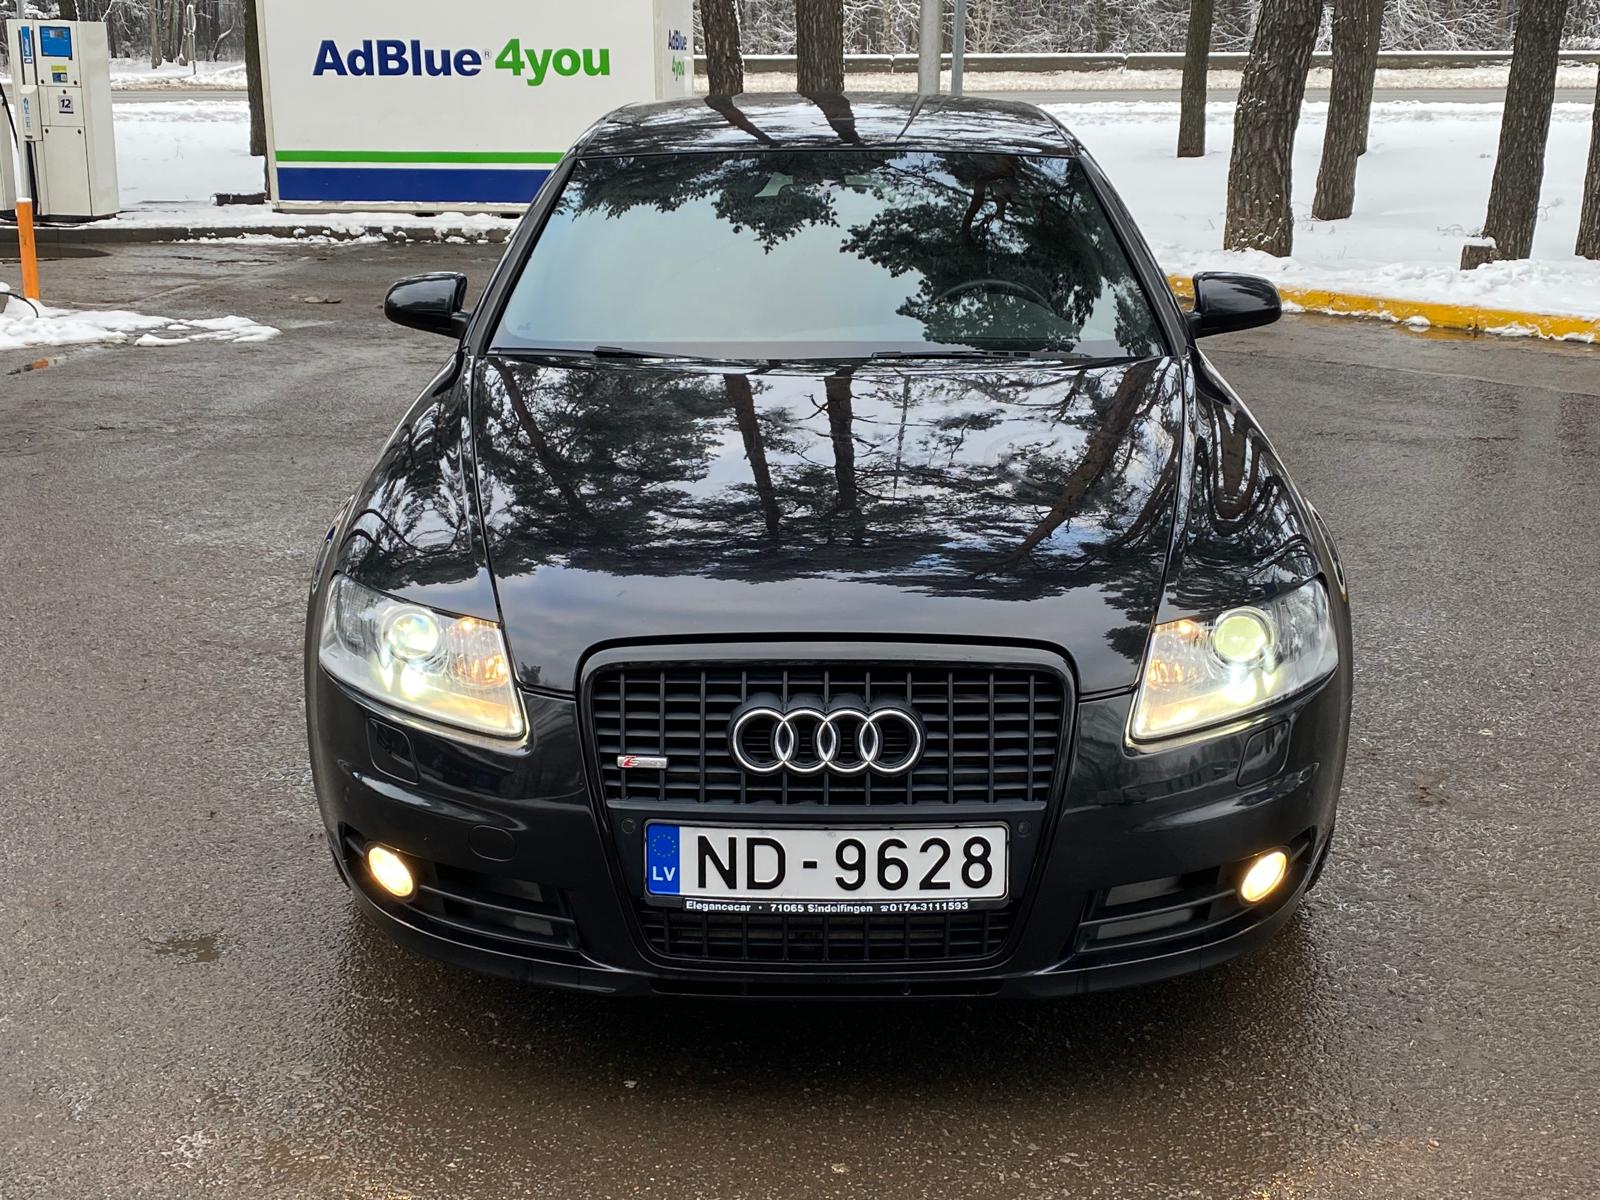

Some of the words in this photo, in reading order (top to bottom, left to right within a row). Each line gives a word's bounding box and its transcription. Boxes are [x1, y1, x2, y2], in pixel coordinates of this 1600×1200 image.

[494, 38, 610, 86] 4you
[60, 99, 71, 108] 12
[652, 867, 676, 881] LV
[686, 900, 751, 912] Elegancecar
[770, 904, 804, 912] 71065
[807, 904, 873, 914] Sindelfingen
